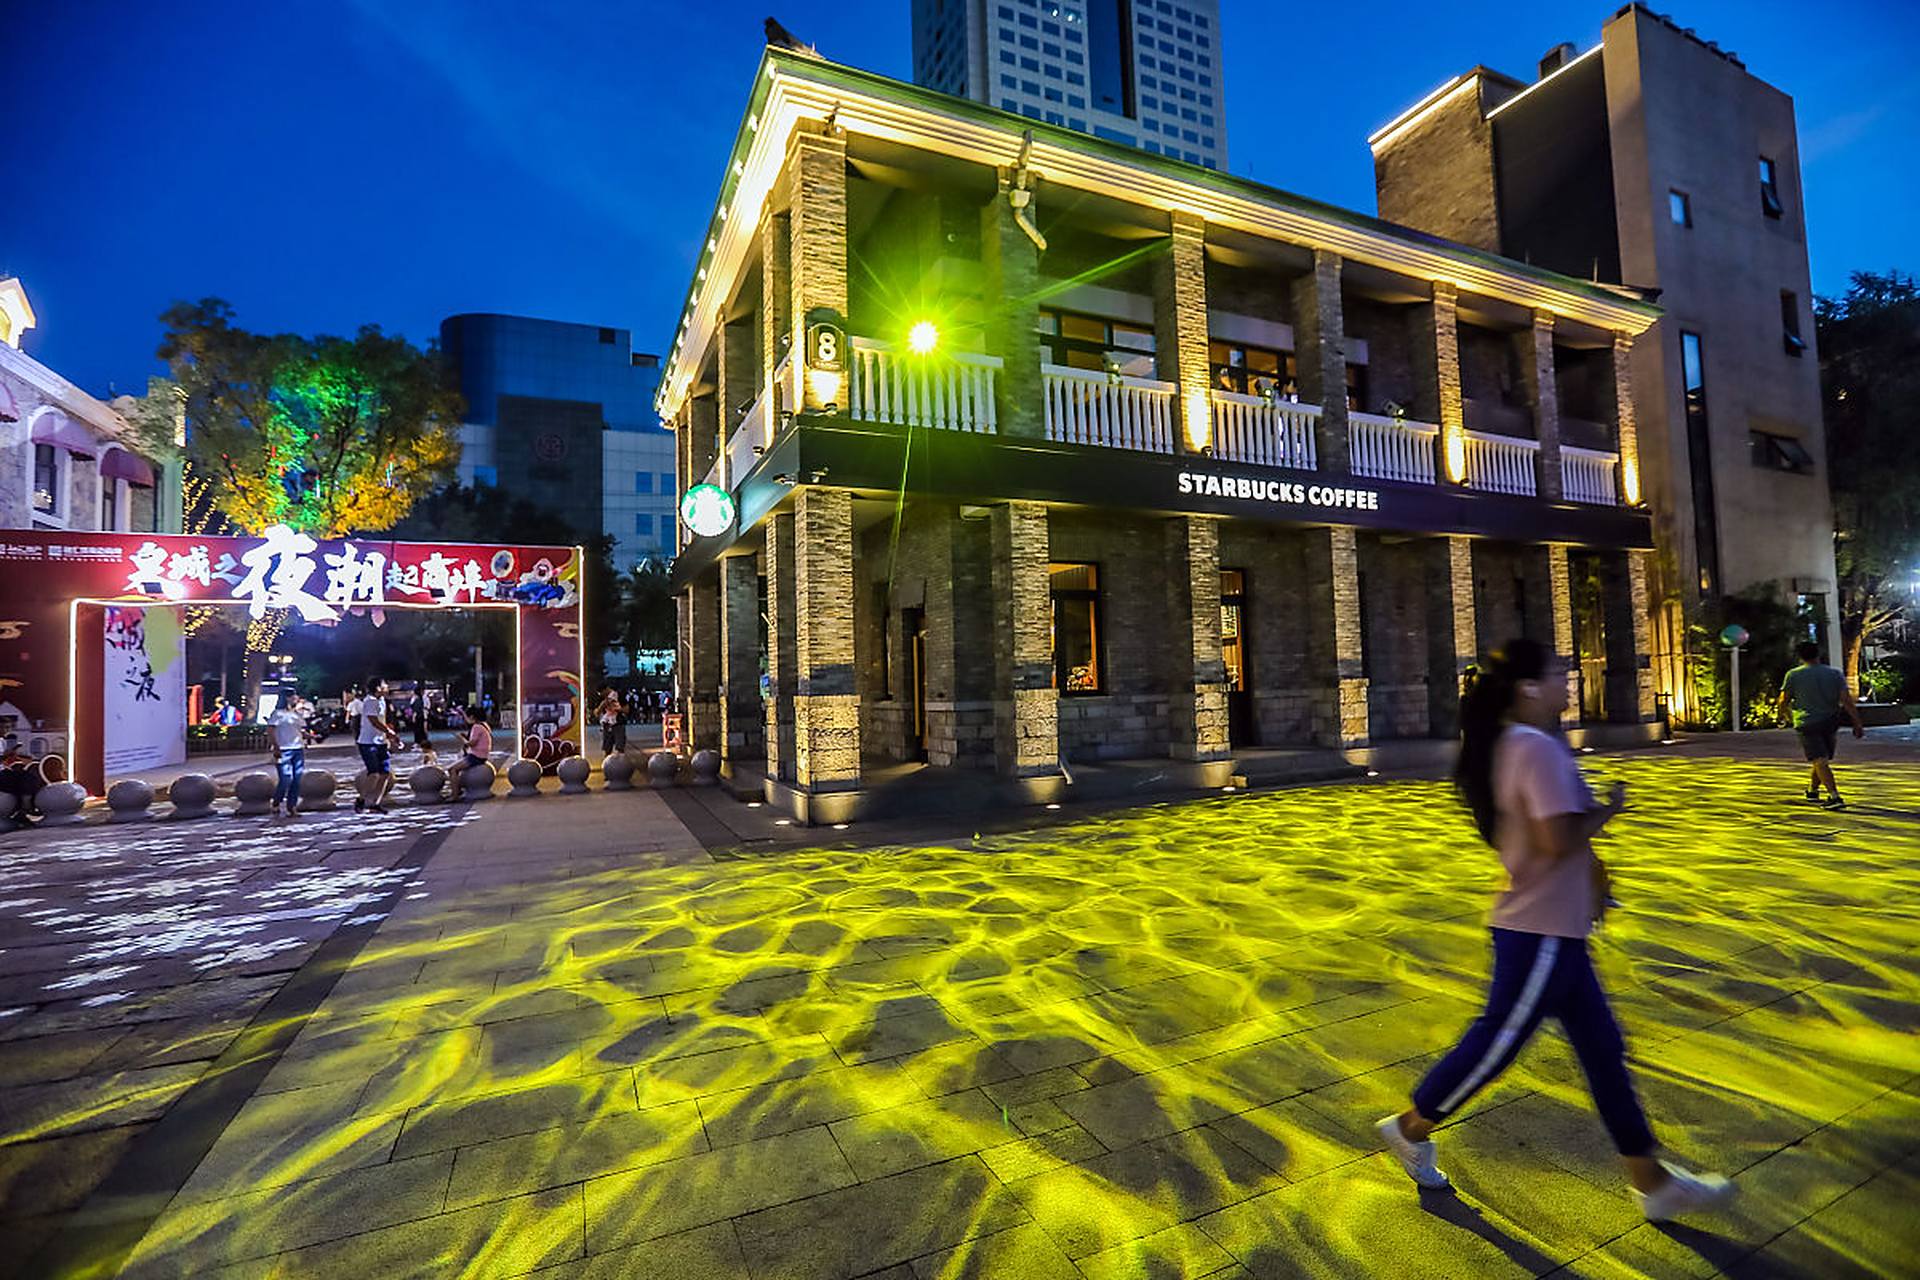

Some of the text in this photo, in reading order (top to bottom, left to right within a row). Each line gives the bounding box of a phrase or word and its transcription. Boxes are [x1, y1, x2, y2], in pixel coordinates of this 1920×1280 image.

[818, 332, 837, 361] 8
[1178, 473, 1379, 510] STARBUCKS COFFEE
